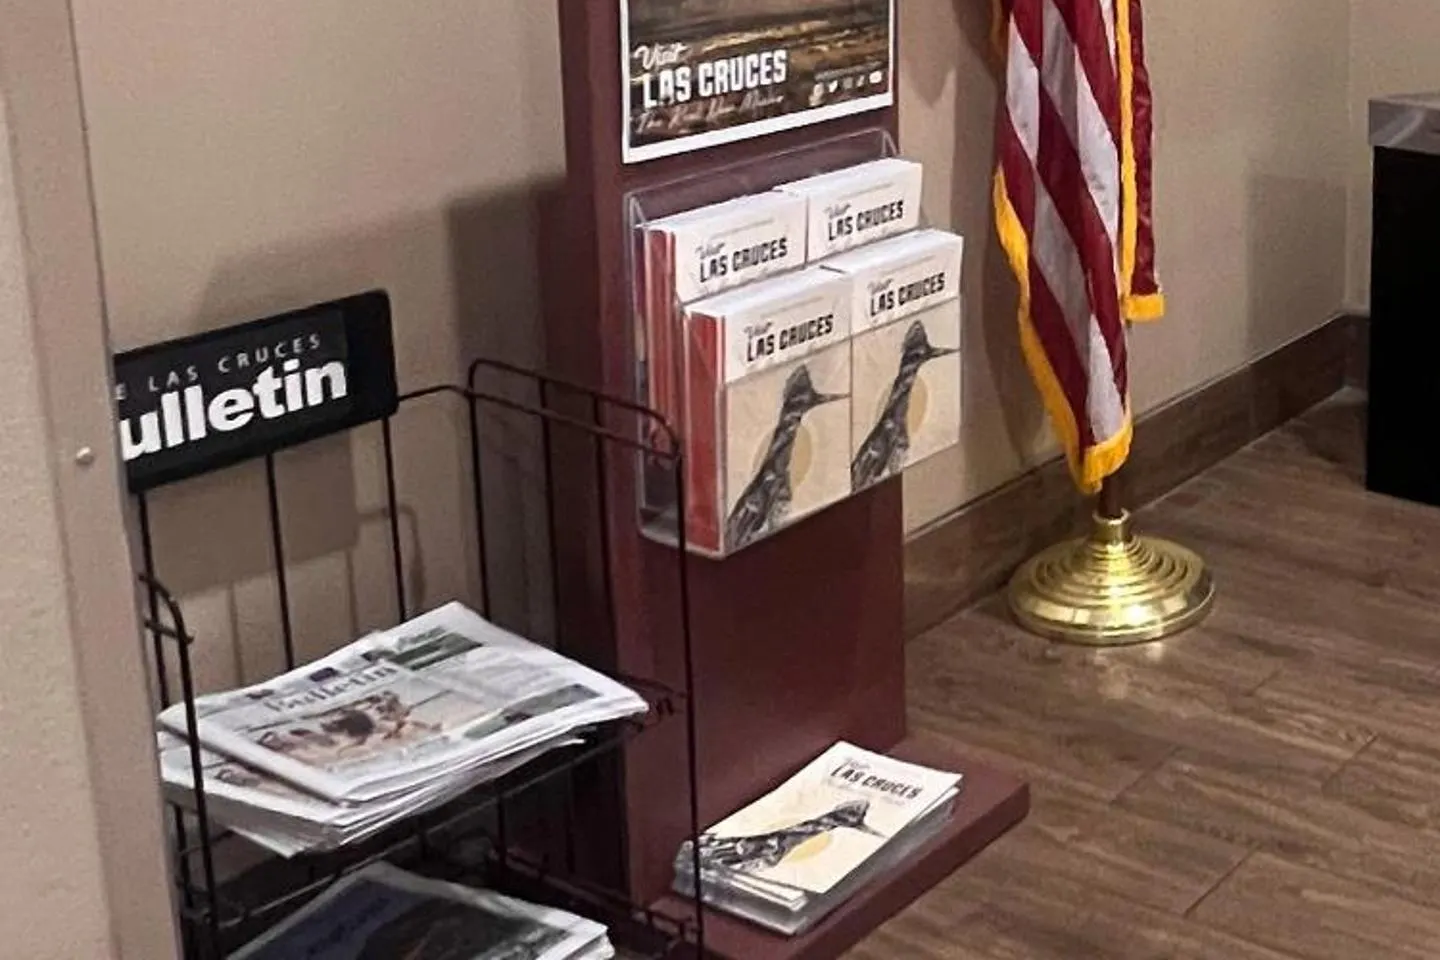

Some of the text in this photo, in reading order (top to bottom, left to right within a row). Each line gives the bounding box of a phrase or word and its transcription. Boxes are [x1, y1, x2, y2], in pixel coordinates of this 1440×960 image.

[632, 42, 692, 70] Visit
[640, 66, 691, 109] LAS
[699, 49, 788, 98] CRUCES
[828, 200, 904, 241] LAS CRUCES
[700, 237, 788, 283] LAS CRUCES
[869, 272, 945, 316] LAS CRUCES
[747, 314, 834, 362] LAS CRUCES
[149, 365, 199, 392] LAS
[217, 334, 321, 373] CRUCES
[119, 359, 347, 461] ulletin
[830, 765, 924, 800] LAS CRUCES
